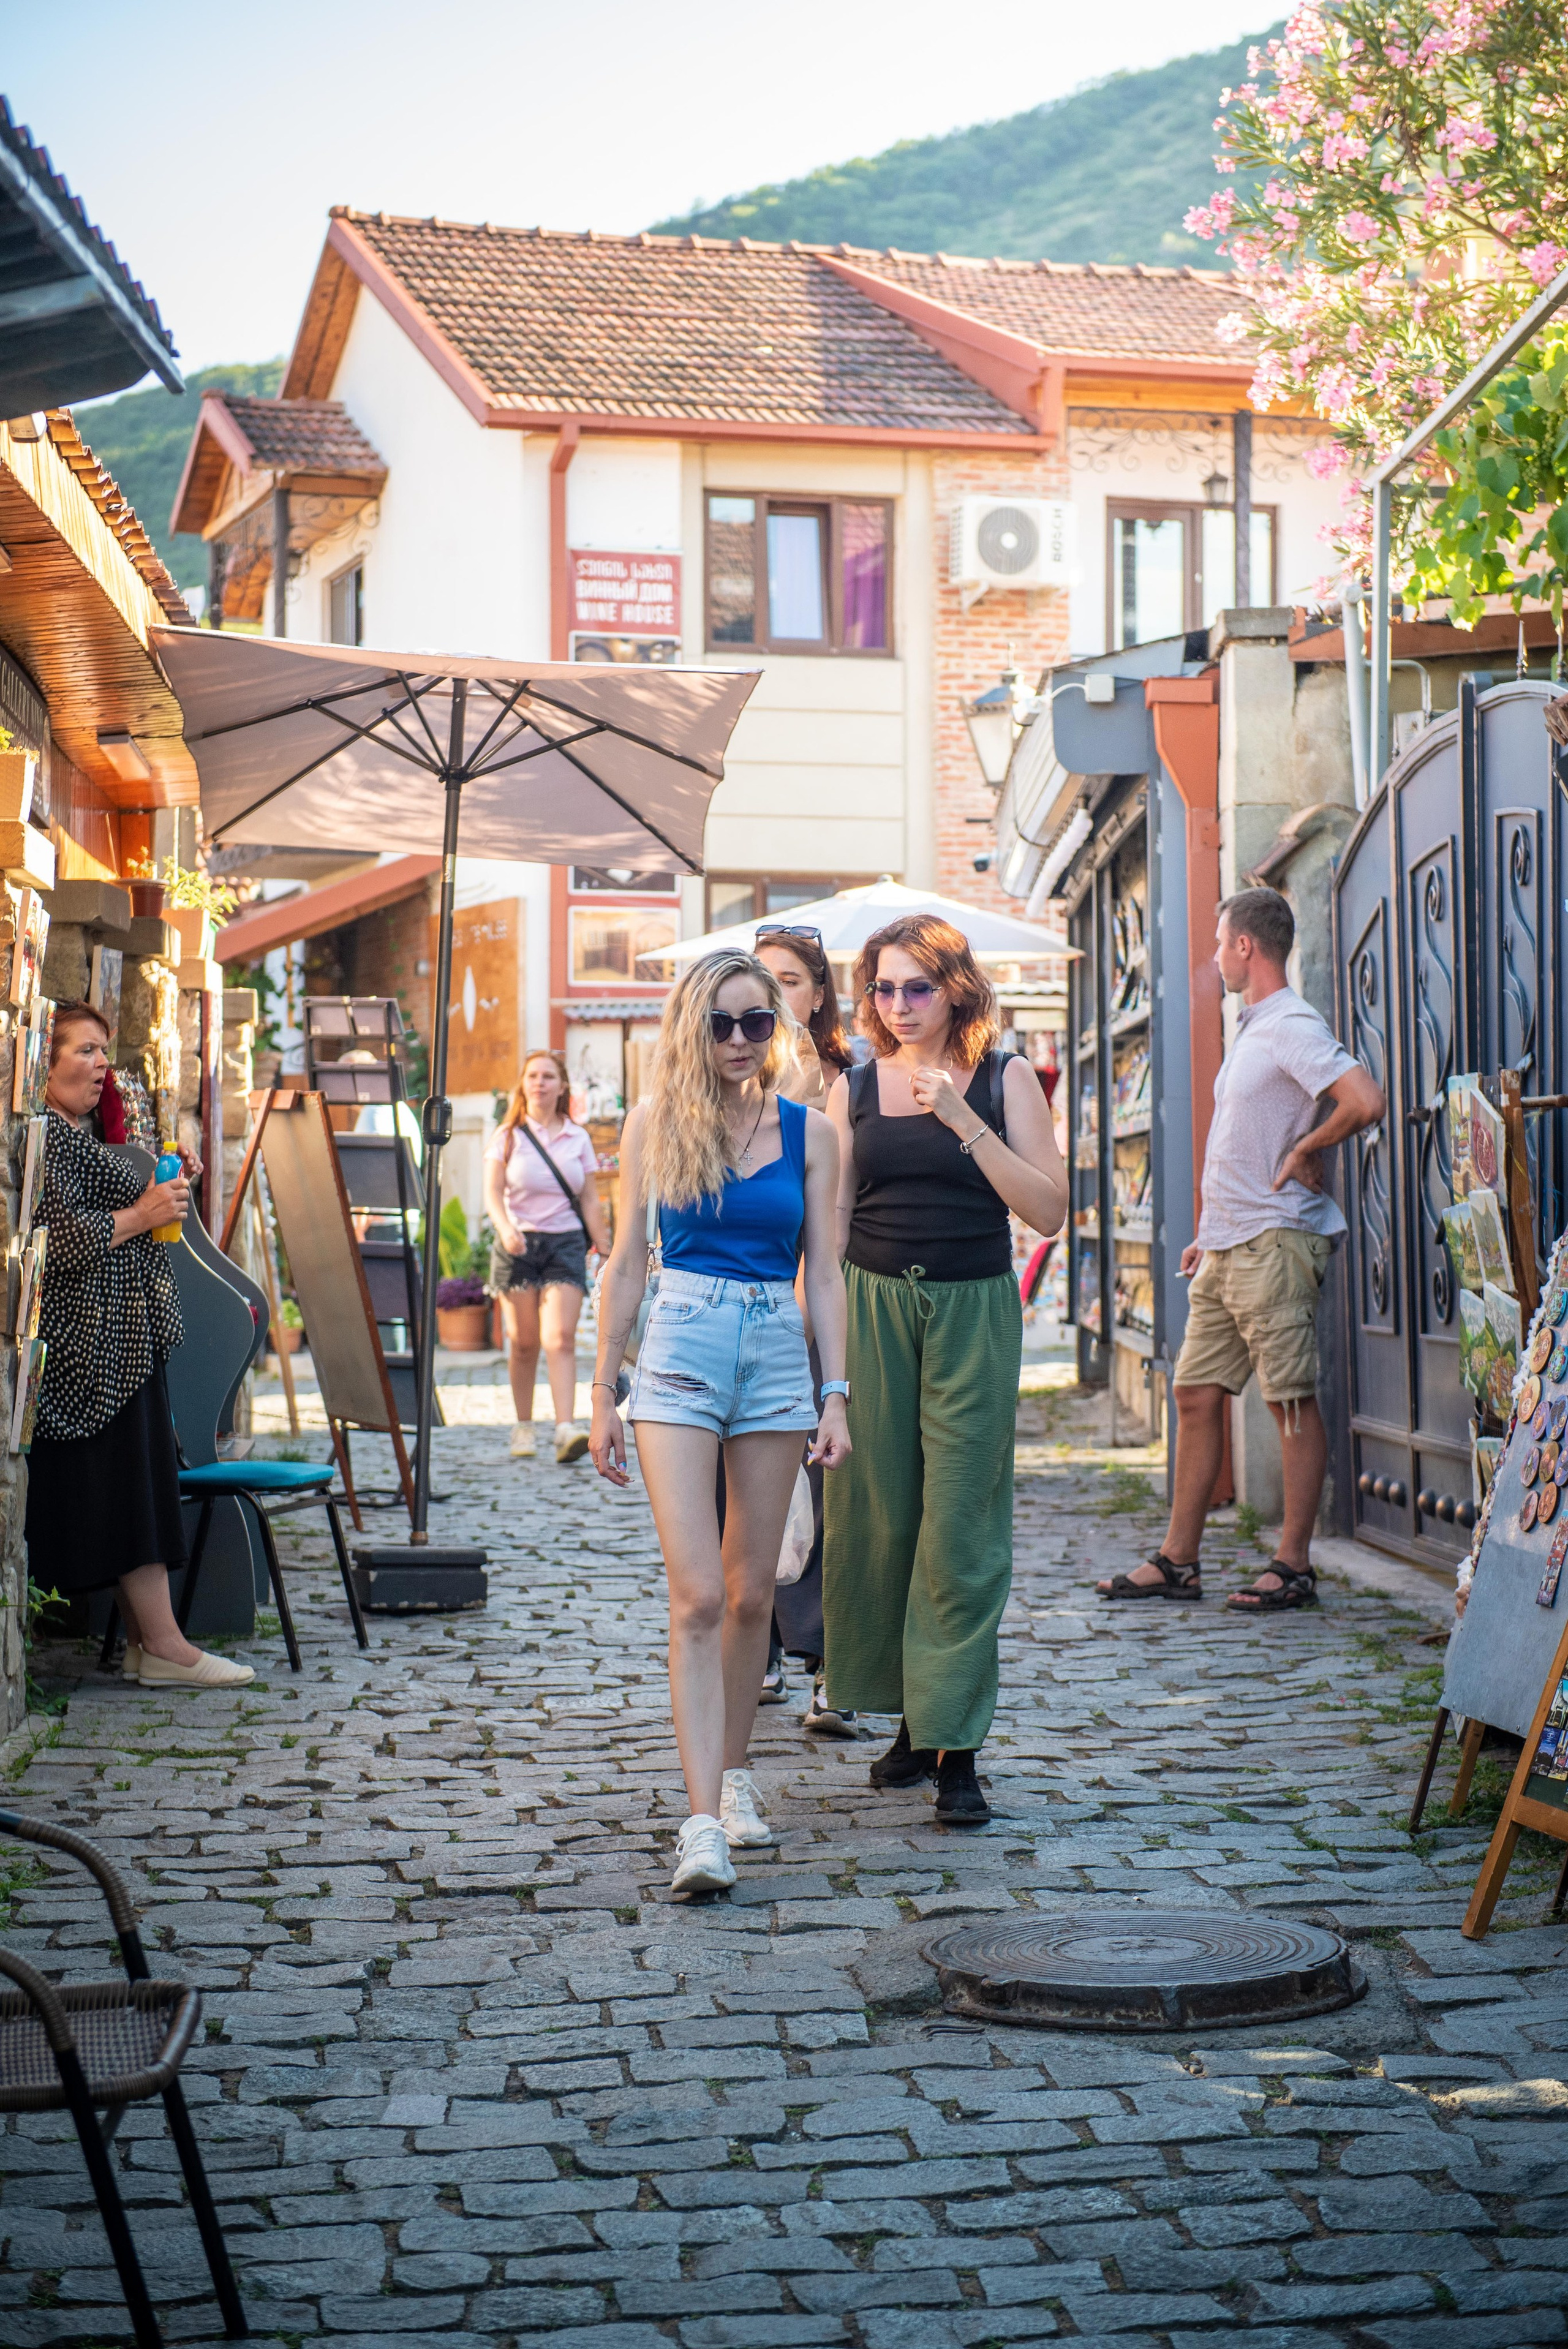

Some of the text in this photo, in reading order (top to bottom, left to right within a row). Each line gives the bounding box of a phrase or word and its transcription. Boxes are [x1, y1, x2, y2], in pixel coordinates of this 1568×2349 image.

[1052, 508, 1063, 562] BOSCH
[576, 578, 673, 602] ВИННЫЙ ДОМ
[576, 601, 674, 625] WINE HOUSE
[2, 660, 29, 729] GALLERY
